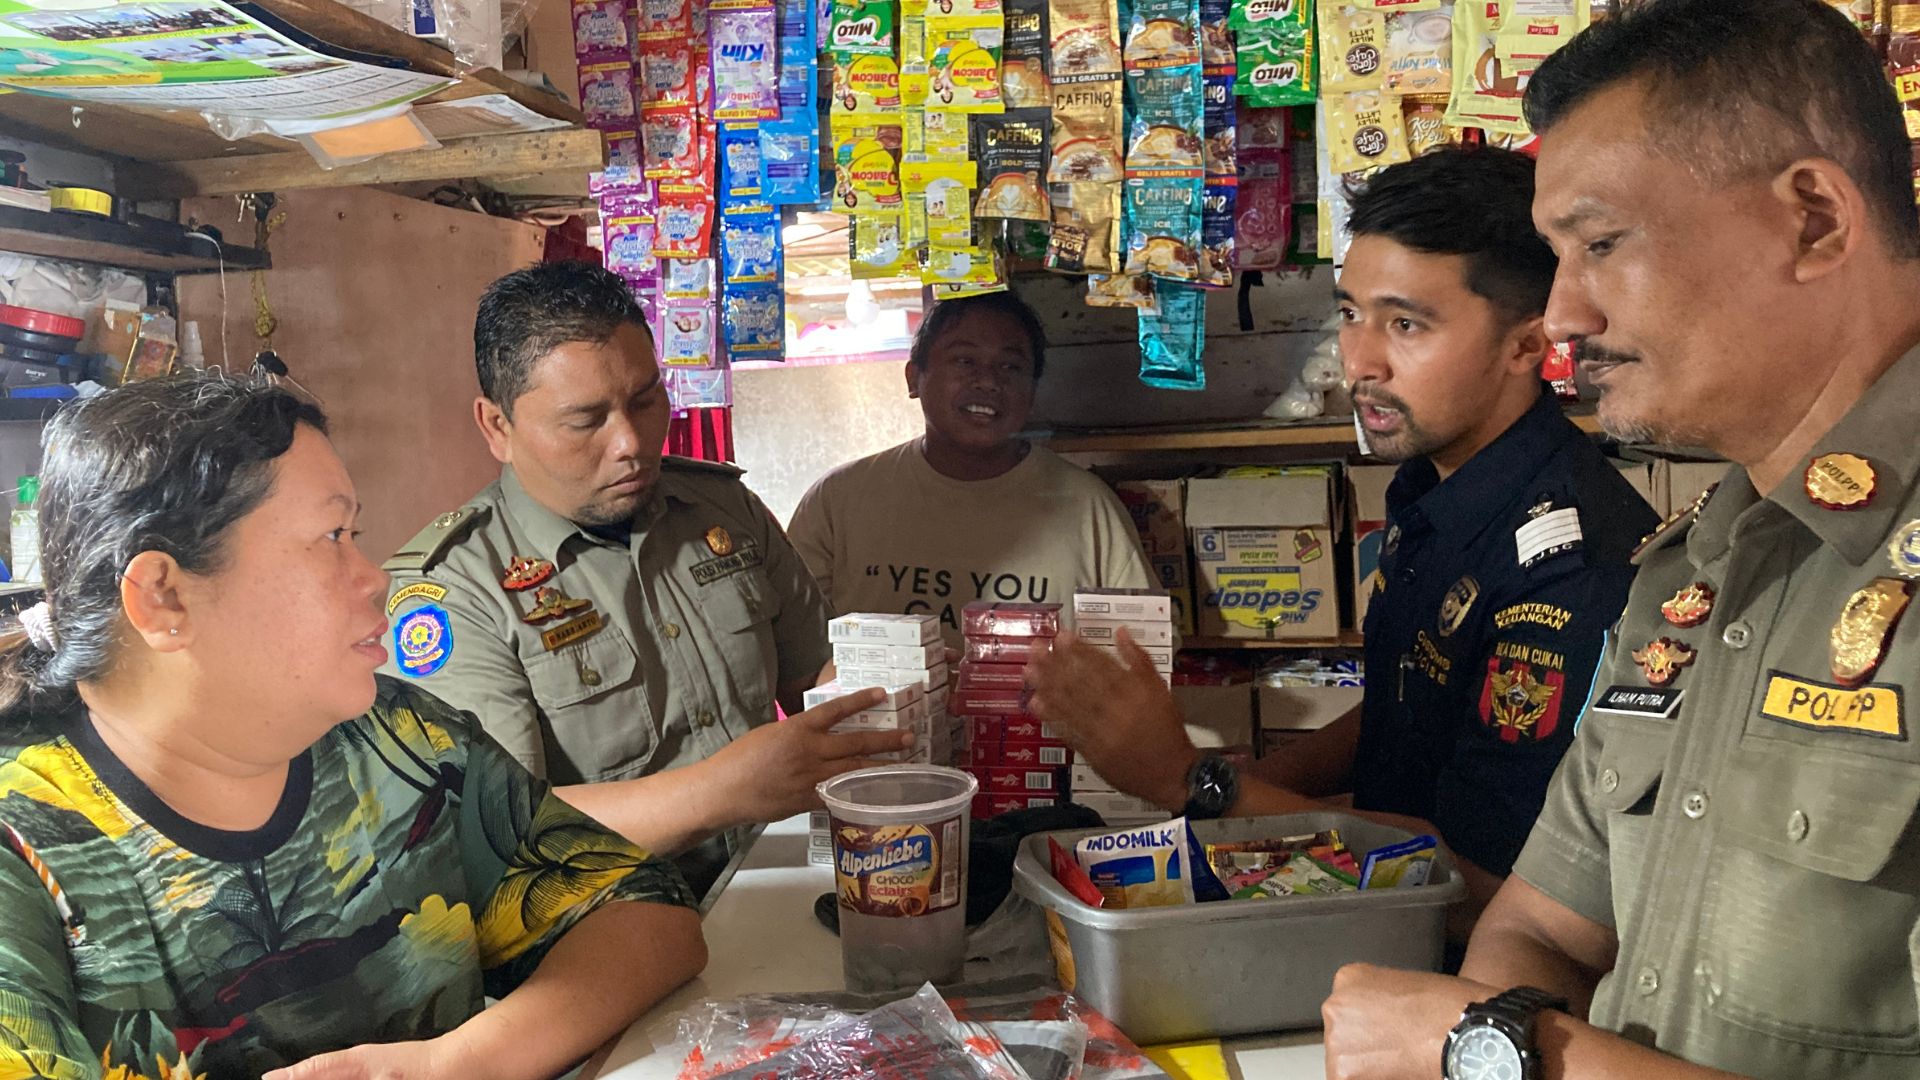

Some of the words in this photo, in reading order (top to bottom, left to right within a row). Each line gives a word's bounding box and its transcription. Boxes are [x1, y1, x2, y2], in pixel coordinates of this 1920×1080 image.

[1152, 3, 1168, 11] ICE
[837, 22, 873, 38] MILO
[1349, 28, 1375, 37] LATTE
[1351, 37, 1374, 45] MILKY
[721, 43, 765, 63] Klin
[851, 73, 898, 88] Dancow
[953, 67, 996, 81] Dancow
[1078, 73, 1109, 82] GRATIS
[1255, 67, 1294, 80] MILO
[730, 90, 762, 101] JUMBO
[1154, 109, 1171, 117] ICE
[1355, 110, 1381, 119] LATTE
[1357, 117, 1381, 126] MILKY
[852, 171, 898, 186] Dancow
[1153, 220, 1171, 228] ICE
[1051, 237, 1082, 253] BOLD
[970, 572, 1048, 603] YOU
[1206, 587, 1322, 614] Sedaap
[1494, 603, 1572, 623] KEMENTERIAN
[1497, 613, 1564, 631] KEUANGAN
[1509, 644, 1530, 662] DAN
[1531, 649, 1564, 670] CUKAI
[1608, 691, 1638, 704] ILHAM
[1635, 693, 1665, 707] PUTRA
[1086, 829, 1174, 851] INDOMILK
[840, 839, 923, 879] Alpenliebe
[876, 874, 915, 886] CHOCO
[868, 885, 913, 897] Eclairs
